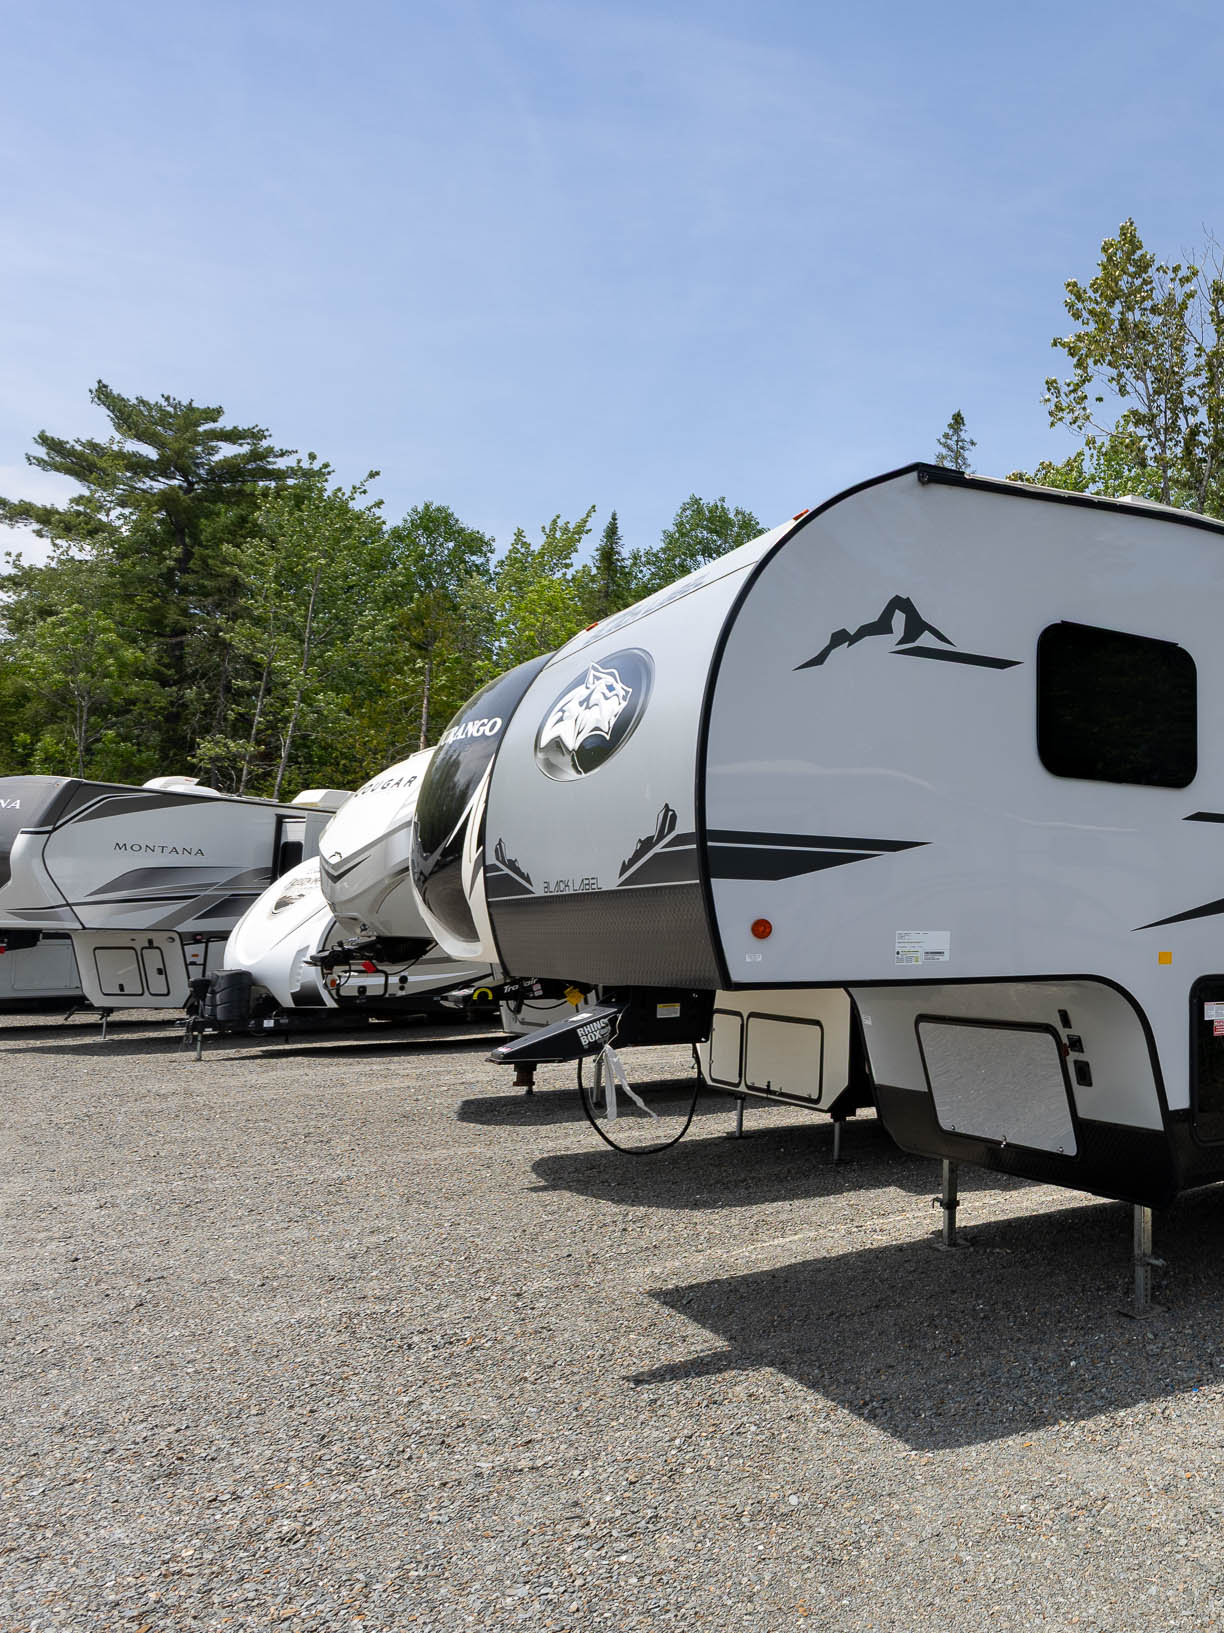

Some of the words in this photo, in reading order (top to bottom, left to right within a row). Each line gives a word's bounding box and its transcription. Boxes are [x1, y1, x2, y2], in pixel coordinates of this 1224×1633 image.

[113, 842, 205, 857] MONTANA
[543, 879, 570, 894] BLACK
[572, 877, 602, 892] LABEL
[580, 1030, 602, 1046] BOX
